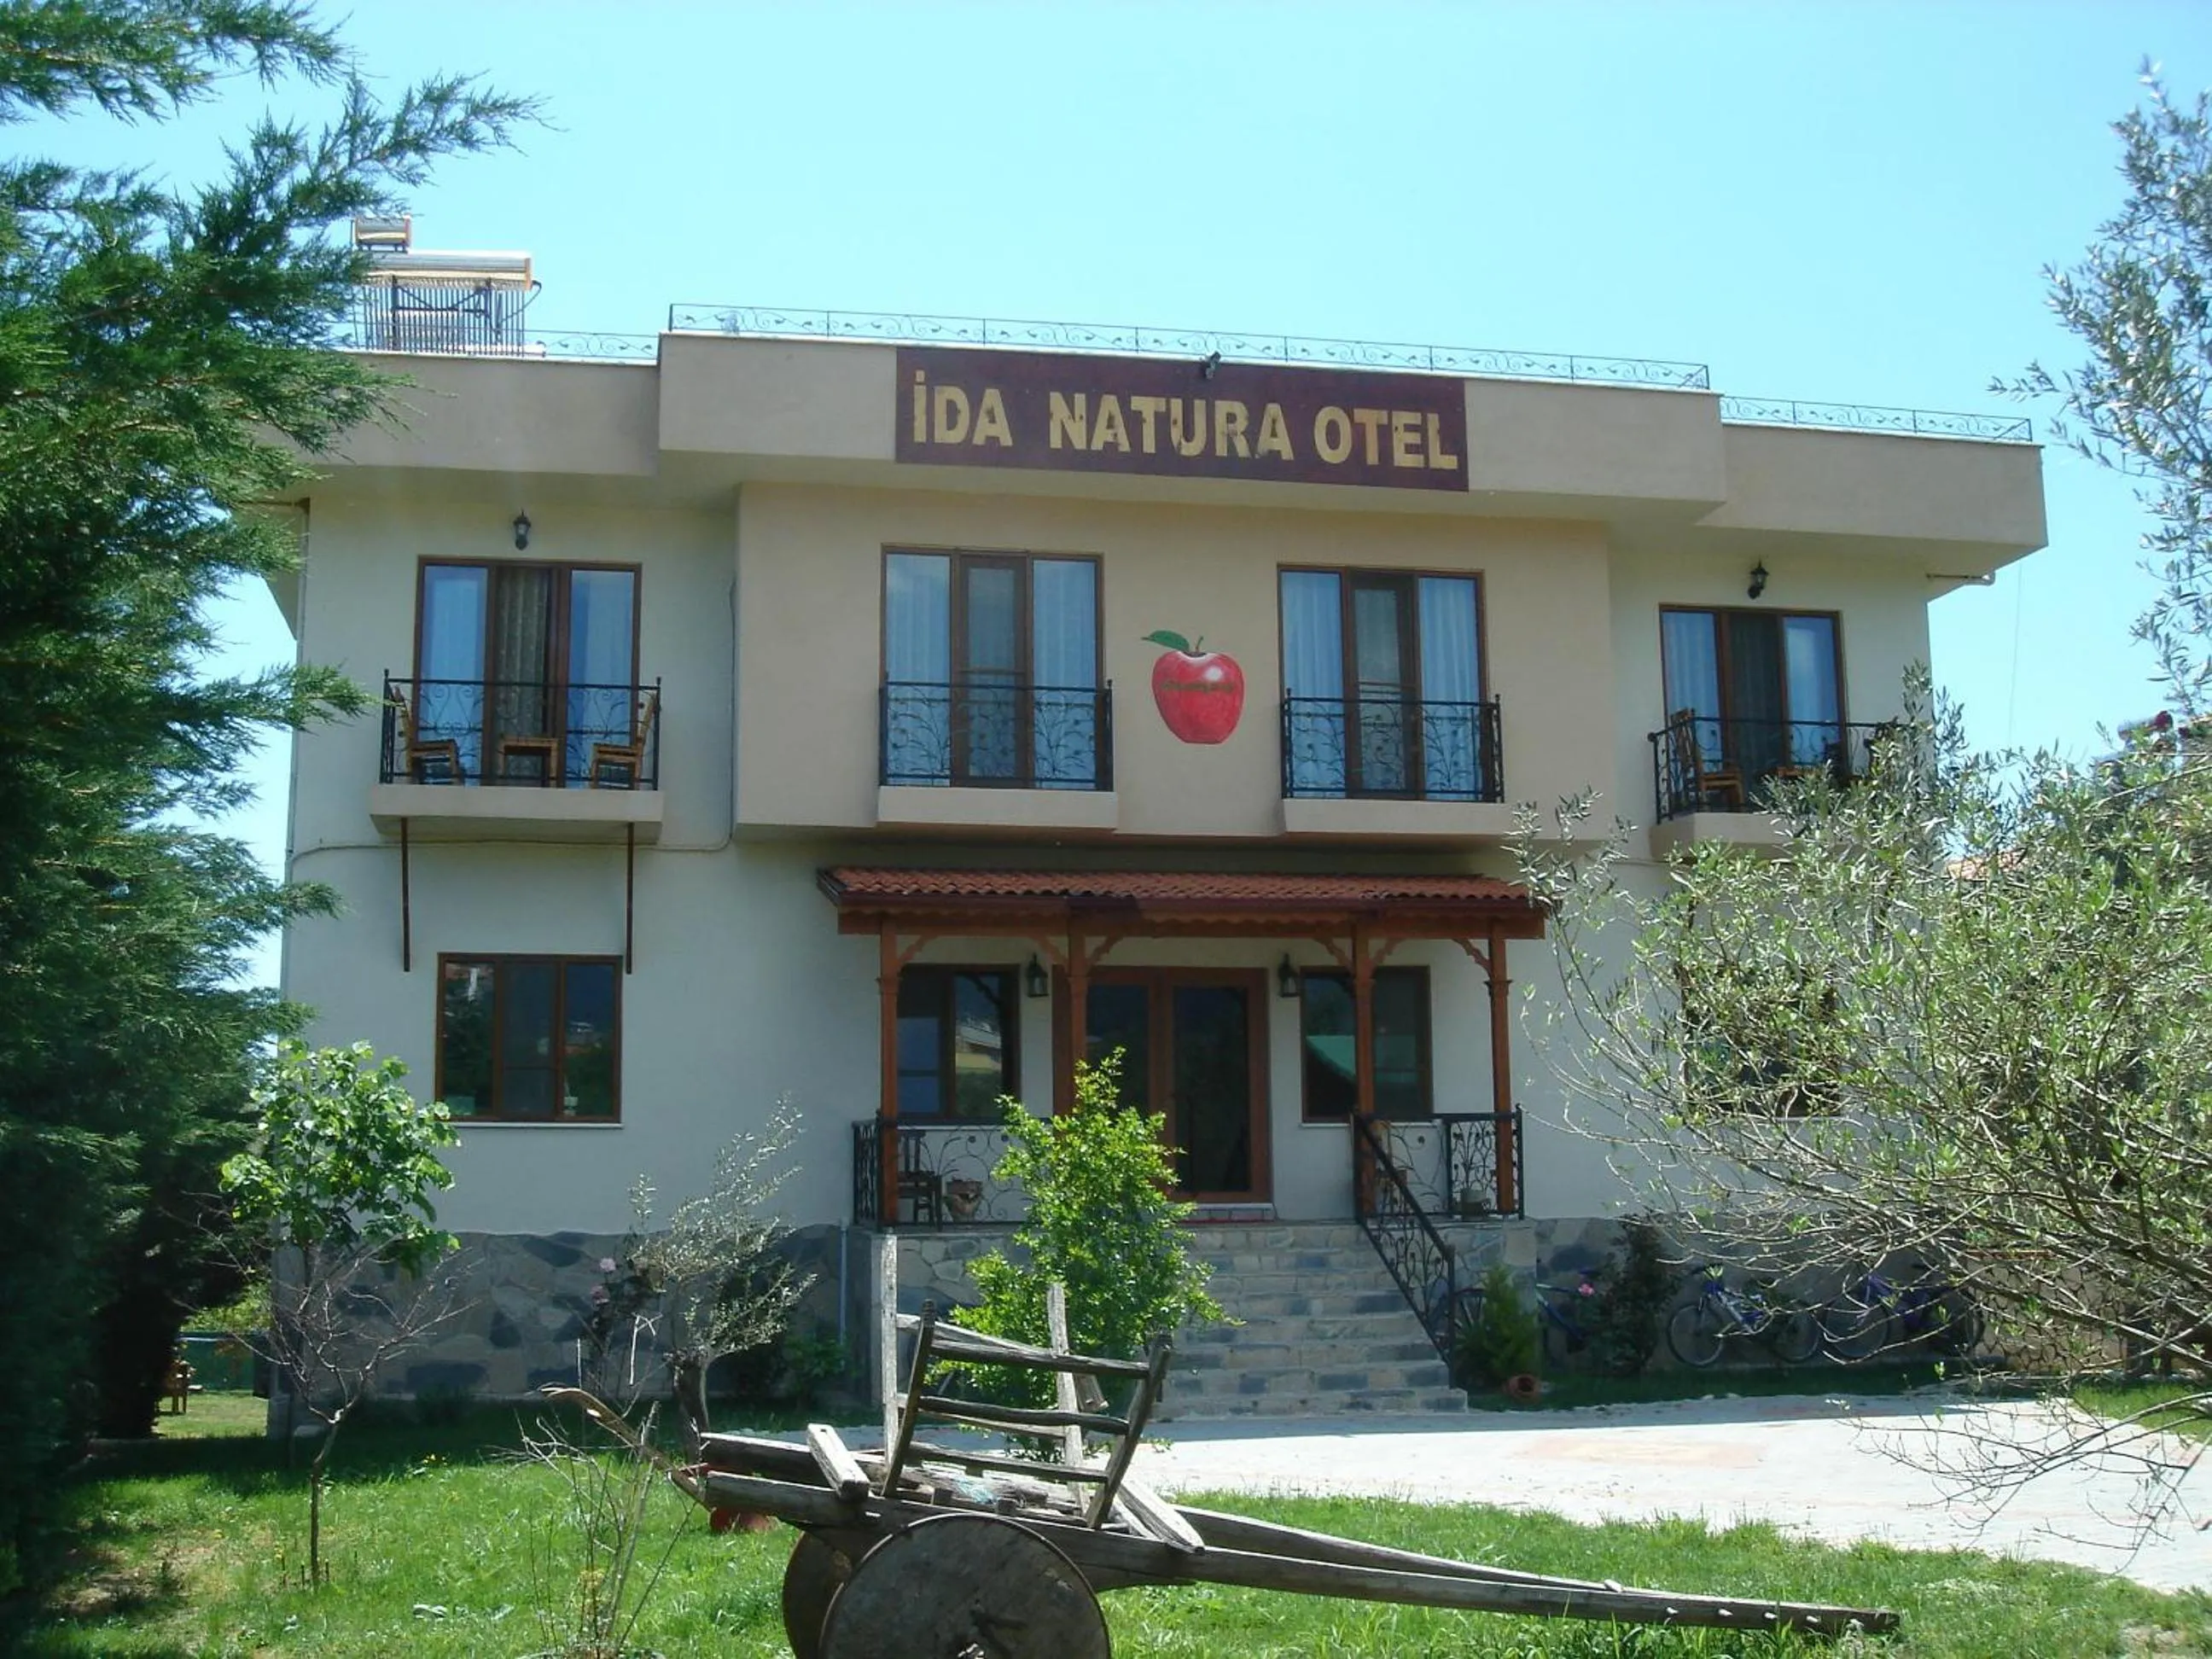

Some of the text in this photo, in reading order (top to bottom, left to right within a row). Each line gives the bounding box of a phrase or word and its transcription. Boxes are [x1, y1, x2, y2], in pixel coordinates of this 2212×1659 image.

[913, 370, 1458, 470] İDA NATURA OTEL
